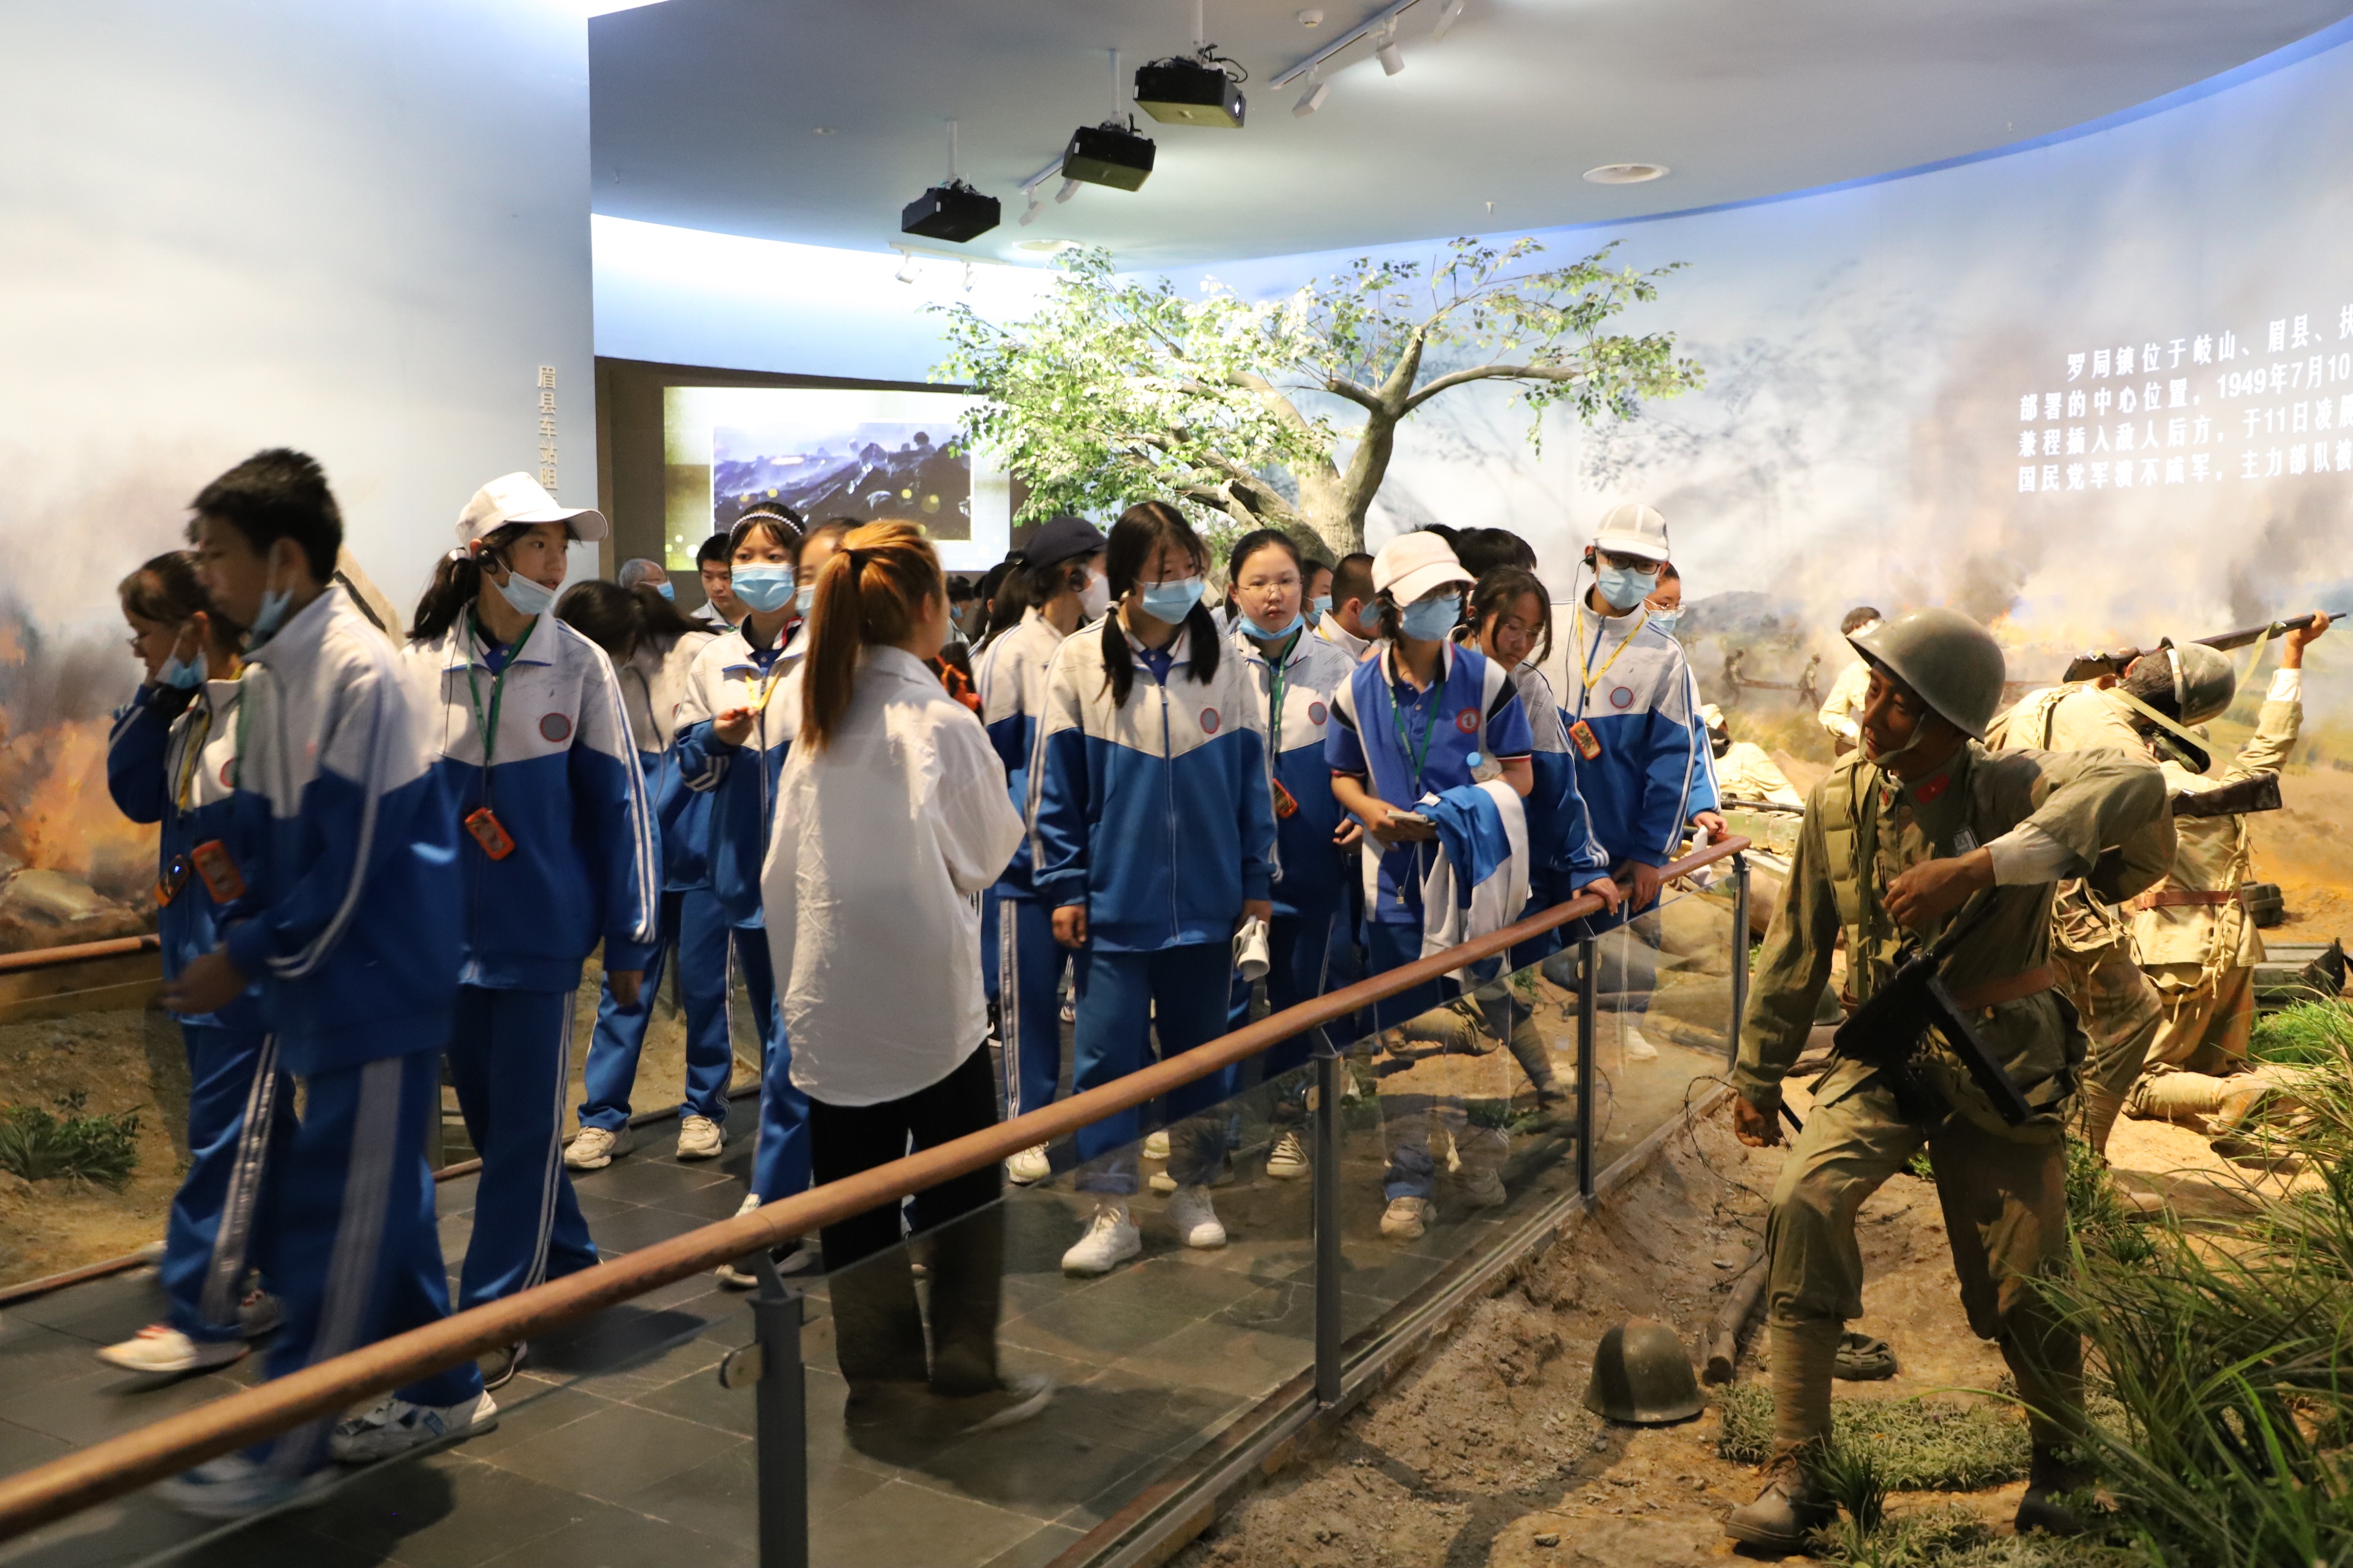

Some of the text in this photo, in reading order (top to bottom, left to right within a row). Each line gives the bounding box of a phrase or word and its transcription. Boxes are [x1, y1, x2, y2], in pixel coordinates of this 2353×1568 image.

[538, 365, 558, 503] 眉县车站阻
